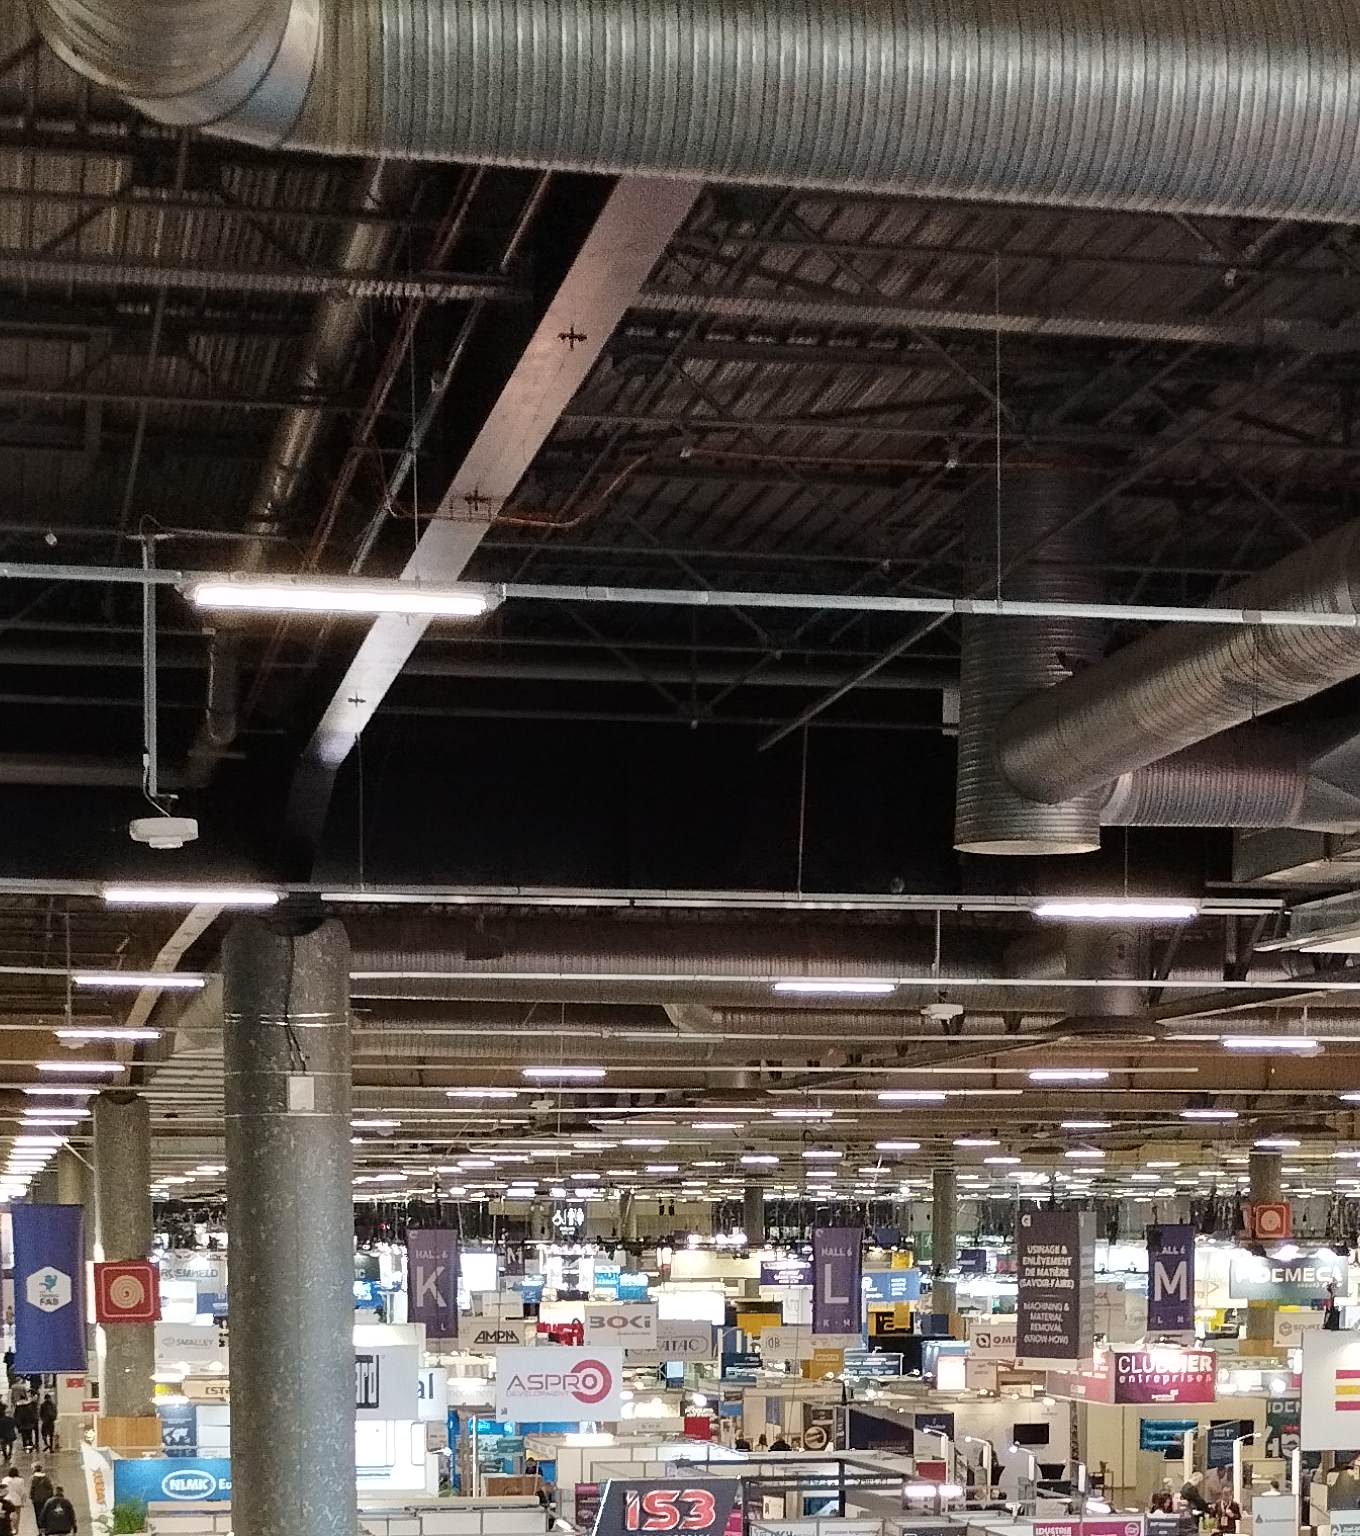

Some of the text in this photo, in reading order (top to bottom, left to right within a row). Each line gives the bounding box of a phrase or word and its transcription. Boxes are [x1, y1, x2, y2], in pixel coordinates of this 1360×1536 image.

[821, 1247, 853, 1257] HALL 6
[1026, 1245, 1059, 1255] USINAGE
[1025, 1268, 1036, 1278] DE
[416, 1265, 447, 1308] K
[824, 1263, 850, 1304] L
[1153, 1260, 1188, 1302] M
[1023, 1302, 1064, 1312] MACHINING
[1030, 1312, 1064, 1322] MATERIAL
[1030, 1323, 1063, 1333] REMOVAL
[507, 1373, 598, 1391] ASPRO
[1118, 1374, 1213, 1386] entreprises
[169, 1478, 210, 1491] NLMK
[625, 1488, 716, 1532] IS3
